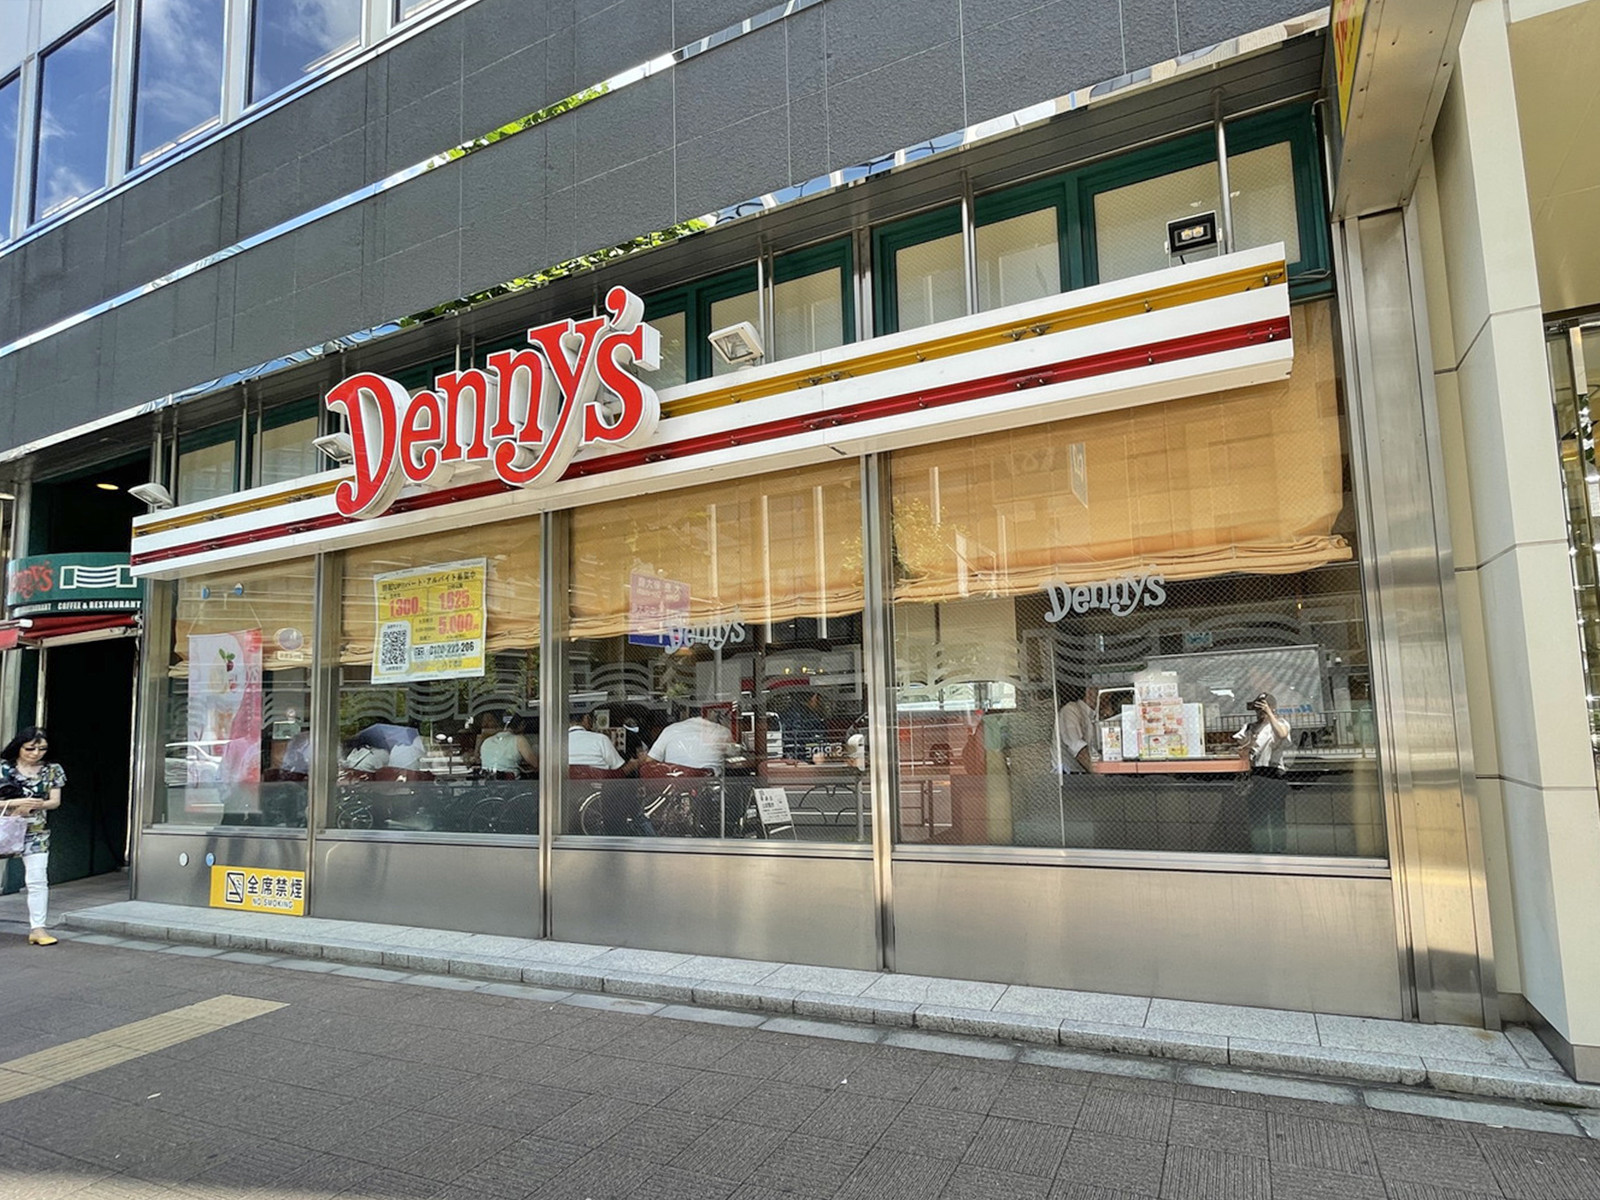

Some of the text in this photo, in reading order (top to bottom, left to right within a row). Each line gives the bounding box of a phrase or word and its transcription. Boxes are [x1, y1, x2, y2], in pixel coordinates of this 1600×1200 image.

[325, 285, 661, 519] Denny's
[57, 601, 82, 610] COFFEE
[89, 600, 141, 609] RESTAURANT
[1044, 564, 1167, 622] Denny's
[247, 875, 303, 899] 全席禁煙
[252, 898, 293, 909] NO SMOKING
